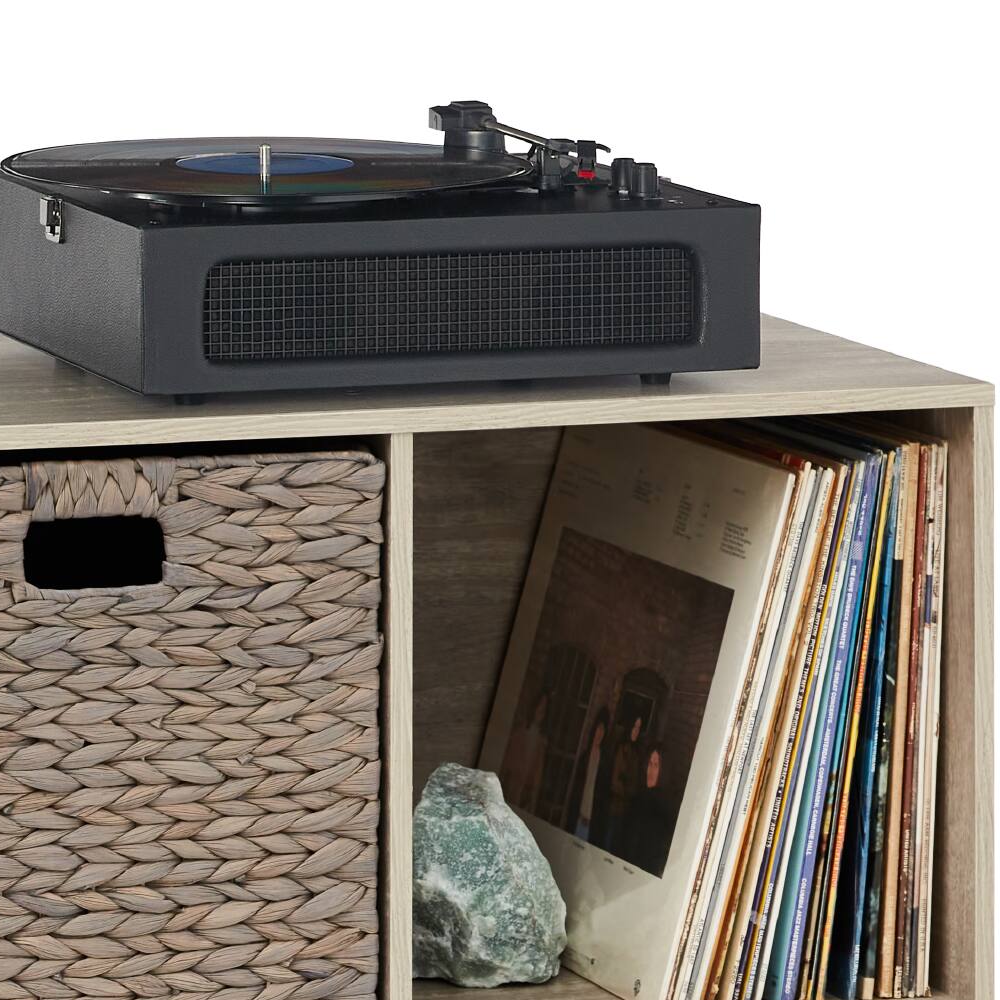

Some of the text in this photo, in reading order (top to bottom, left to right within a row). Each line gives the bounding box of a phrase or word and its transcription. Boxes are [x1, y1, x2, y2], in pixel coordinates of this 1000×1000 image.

[847, 576, 855, 592] DAVE
[842, 592, 852, 621] BRUBECK
[838, 621, 848, 649] QUARTET
[831, 671, 840, 692] GREAT
[765, 584, 827, 848] GOLDEN MOTION PICTURE THEMES AND ORIGINAL SOUNDTRACKS UNITED ARTISTS
[808, 809, 818, 840] CARNEGIE
[805, 840, 813, 856] HALL
[762, 882, 774, 914] COLUMBIA
[783, 877, 807, 994] COLUMBIA JAZZ MASTERPIECES STEREO
